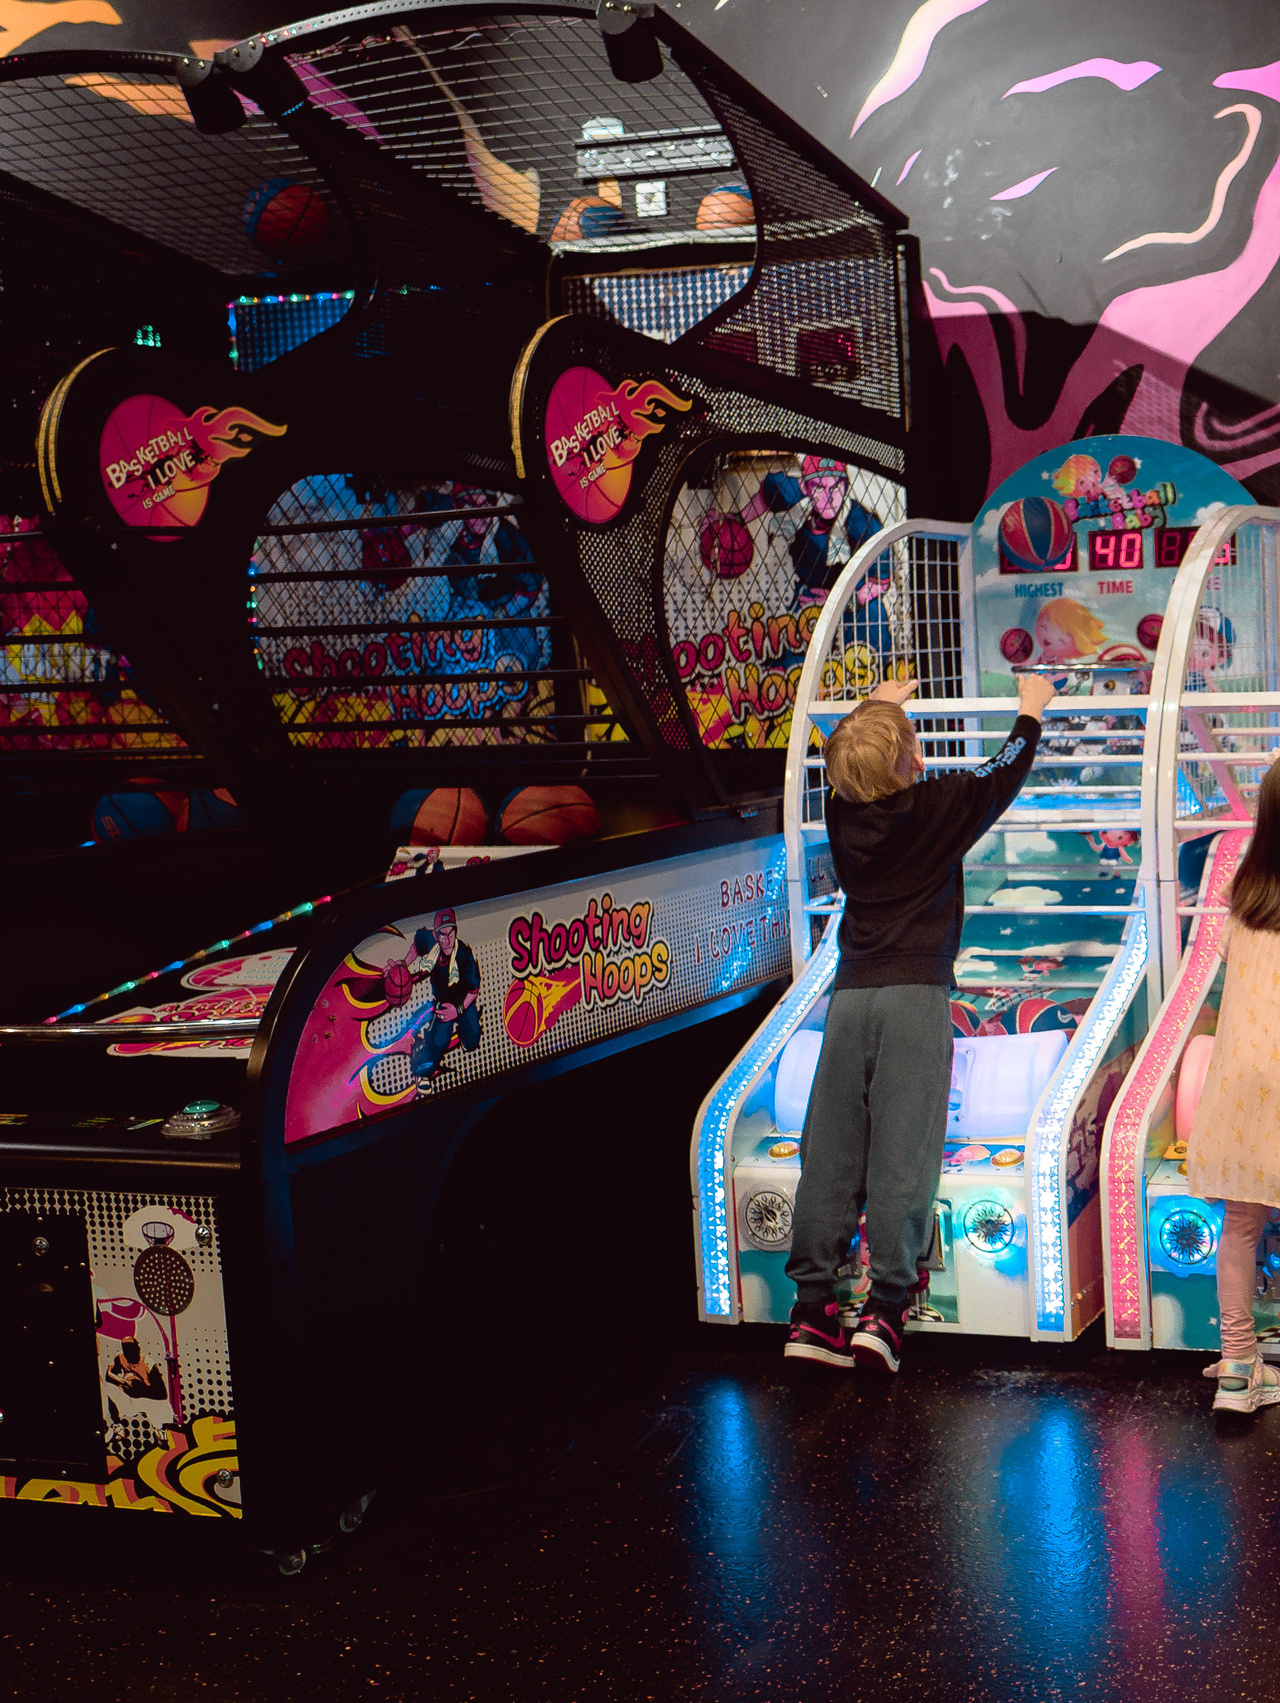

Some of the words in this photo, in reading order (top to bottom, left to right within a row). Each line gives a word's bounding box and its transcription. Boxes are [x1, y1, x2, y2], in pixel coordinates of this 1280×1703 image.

[549, 400, 620, 468] BASKETBALL
[583, 450, 591, 468] I
[589, 424, 622, 462] LOVE
[105, 426, 194, 490] BASKETBALL
[146, 474, 156, 490] I
[155, 448, 197, 484] LOVE
[142, 497, 154, 510] IS
[152, 484, 177, 503] GAME
[579, 475, 589, 489] IS
[1095, 532, 1142, 568] 40
[1013, 582, 1064, 598] HIGHEST
[1098, 580, 1134, 595] TIME
[672, 602, 825, 678] ootin
[508, 892, 652, 974] Shooting
[710, 920, 756, 959] LOVE
[760, 907, 791, 942] THI
[580, 940, 670, 1005] Hoops
